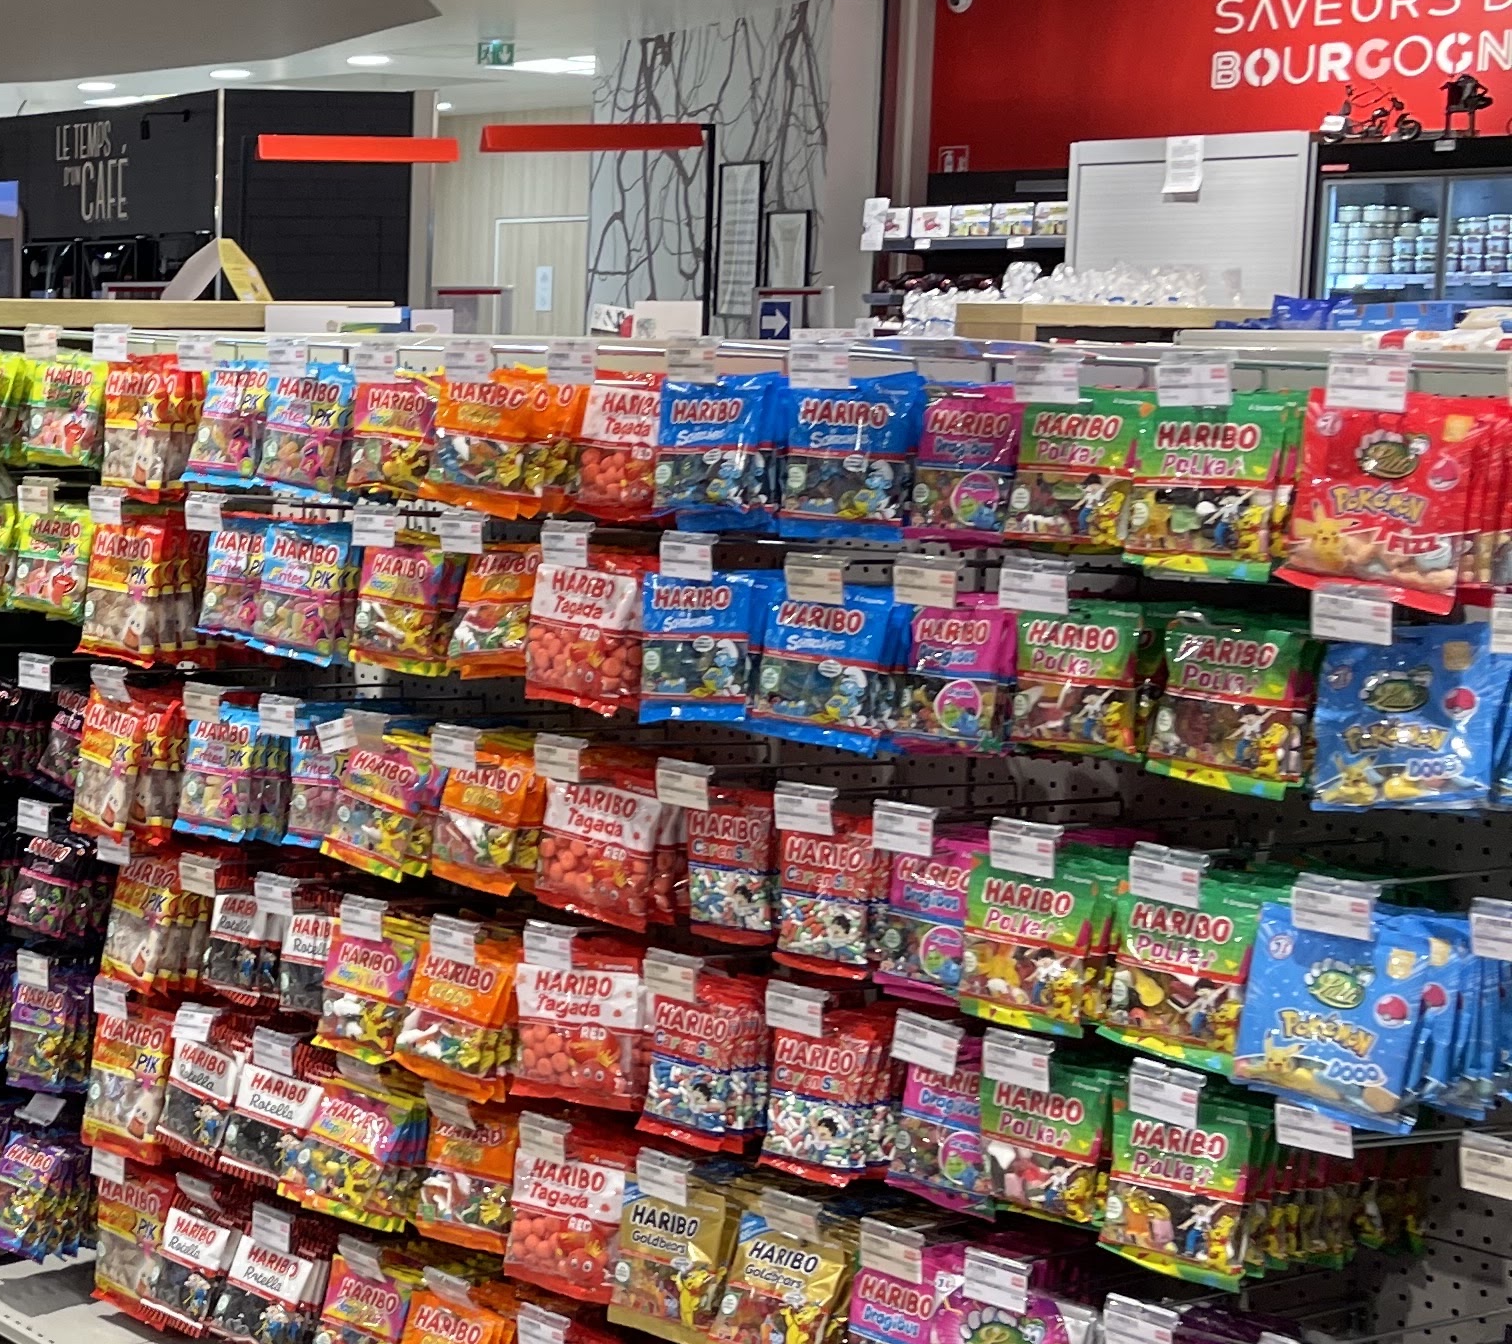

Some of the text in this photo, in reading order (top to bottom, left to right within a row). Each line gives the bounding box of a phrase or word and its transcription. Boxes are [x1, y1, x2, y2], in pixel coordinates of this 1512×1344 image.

[1210, 29, 1512, 90] BOURGOGN
[55, 120, 112, 161] LE TEMPS
[81, 144, 130, 223] CAFÉ
[45, 366, 94, 387] HARIBO
[216, 369, 268, 390] HARIBO
[277, 376, 340, 404] HARIBO
[368, 388, 426, 414] HARIBO
[672, 398, 743, 424] HARIBO
[799, 398, 889, 430] HARIBO
[928, 409, 1012, 439] HARIBO
[1032, 411, 1123, 442] HARIBO
[1155, 421, 1262, 452] HARIBO
[1162, 453, 1228, 478] Polka
[32, 518, 82, 539] HARIBO
[214, 531, 265, 556] HARIB
[94, 531, 154, 562] HARIBO
[272, 536, 340, 566] HARIBO
[372, 553, 428, 582] HARIBO
[552, 569, 616, 599] HARIBO
[654, 585, 732, 611] HARIBO
[554, 594, 603, 620] Tagada
[777, 603, 866, 635] HARIBO
[914, 619, 990, 645] HARIBO
[1027, 619, 1121, 653] HARIBO
[1032, 649, 1090, 677] Polka
[88, 704, 138, 737] HARIBO
[353, 750, 415, 786] HARIBO
[564, 783, 640, 820] HARIBO
[565, 806, 626, 839] Tagada
[691, 809, 764, 844] HARIBO
[785, 835, 864, 873] HARIBO
[983, 876, 1075, 918] HARIBO
[291, 916, 332, 940] HARIB
[985, 909, 1044, 938] Polka
[1131, 902, 1235, 944] HARIBO
[292, 937, 329, 959] Rotell
[339, 944, 397, 976] HARIBO
[423, 954, 495, 992] HARIBO
[534, 970, 613, 1000] HARIBO
[536, 994, 601, 1020] Tagada
[653, 1000, 730, 1043] HARIBO
[101, 1016, 166, 1051] HARIBO
[178, 1044, 228, 1076] HARIBO
[774, 1034, 858, 1075] HARIBO
[249, 1071, 312, 1105] HARIBO
[913, 1064, 981, 1097] HARIB
[993, 1081, 1085, 1126] HARIBO
[999, 1110, 1058, 1143] Polka
[1131, 1120, 1230, 1162] HARIBO
[531, 1159, 607, 1193] HARIBO
[1134, 1150, 1195, 1181] Polka
[98, 1179, 161, 1215] HARIBO
[529, 1180, 589, 1209] Tagada
[174, 1217, 219, 1246] HARIBO
[630, 1203, 700, 1239] HARIBO
[631, 1228, 688, 1255] Goldbears
[747, 1238, 821, 1275] HARIBO
[247, 1245, 300, 1280] HARIBO
[339, 1277, 401, 1316] HARIBO
[859, 1271, 936, 1320] HARIBO
